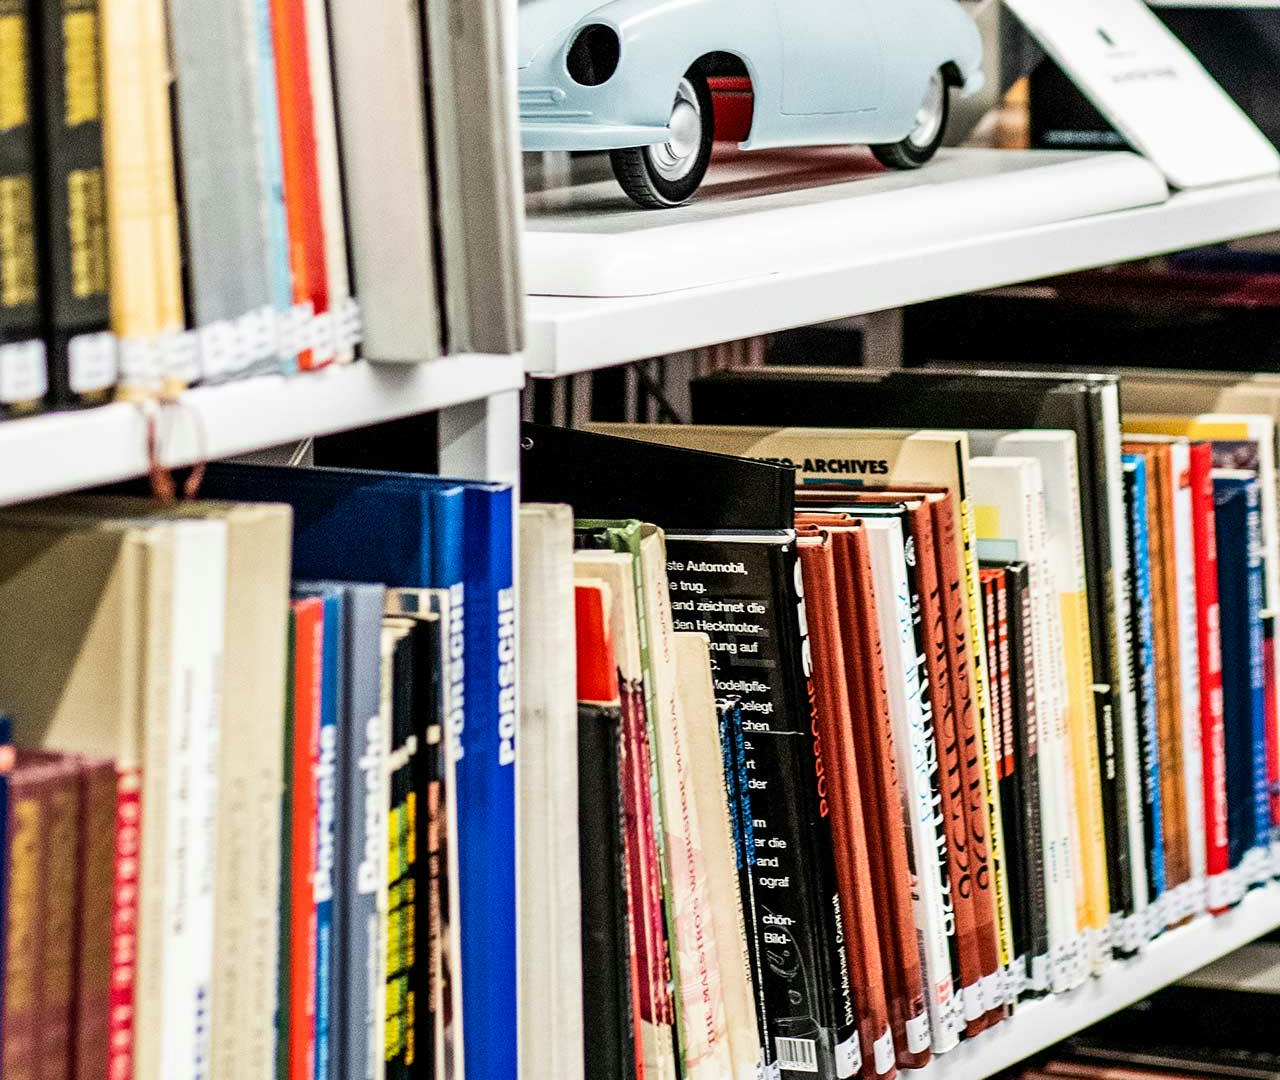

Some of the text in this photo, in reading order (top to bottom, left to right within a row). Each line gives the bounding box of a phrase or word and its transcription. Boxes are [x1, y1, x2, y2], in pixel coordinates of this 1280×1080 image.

[751, 457, 888, 474] O-ARCHIVES
[686, 561, 748, 575] Automobil,
[680, 582, 707, 593] trug.
[697, 600, 745, 612] zeichnet
[747, 602, 766, 614] die
[696, 620, 764, 633] Heckmotor-
[739, 642, 759, 653] auf
[497, 586, 515, 767] PORSCHE
[806, 680, 829, 818] PORSCHE
[768, 837, 787, 849] die
[764, 933, 791, 945] Bild-
[705, 1008, 717, 1046] THE
